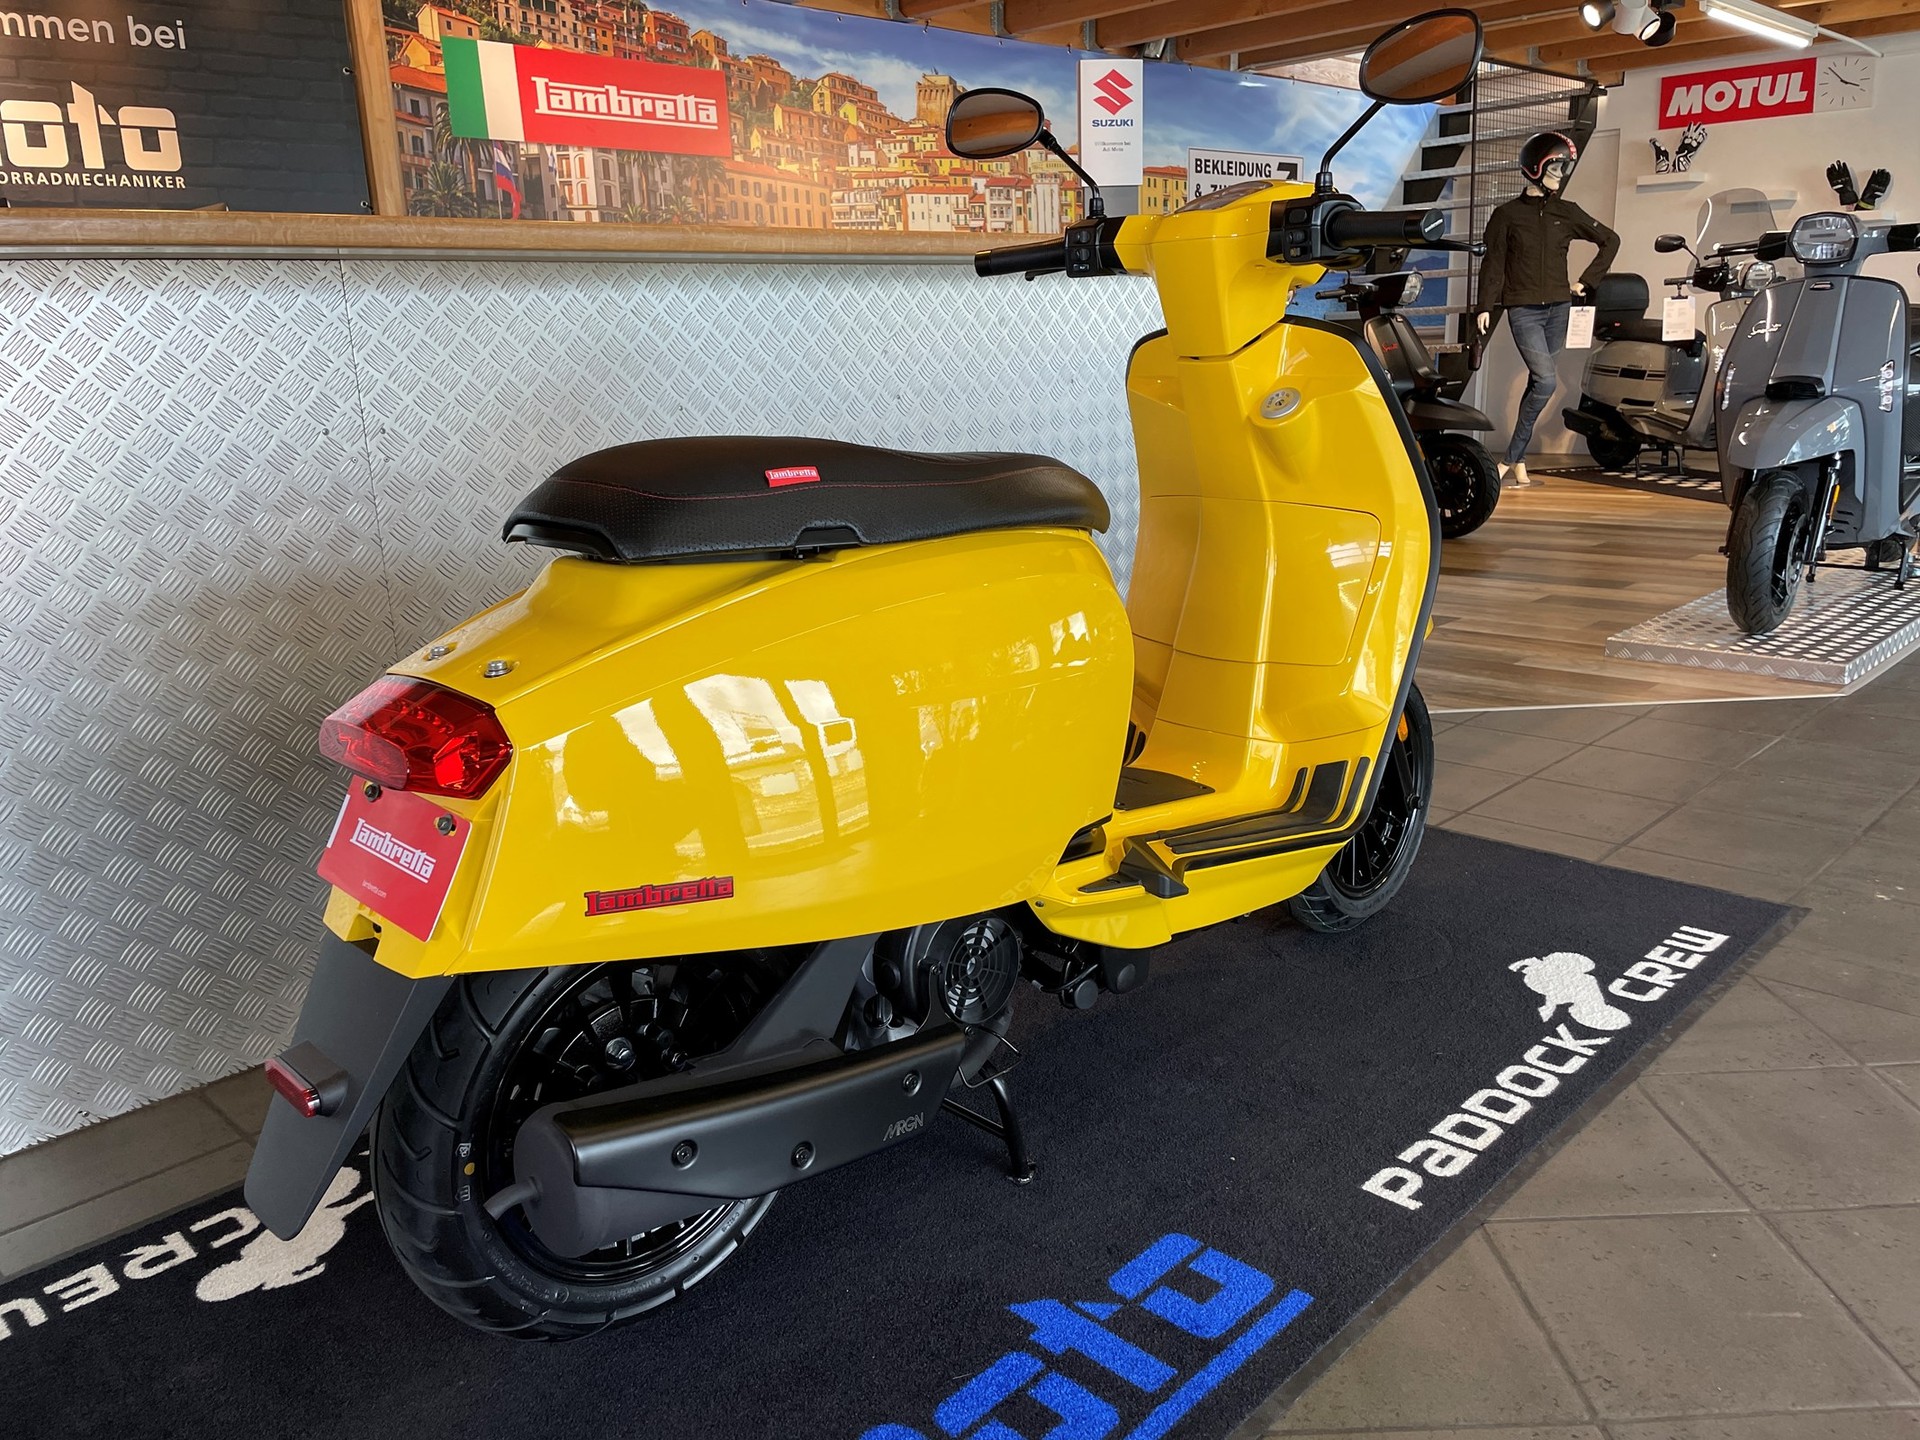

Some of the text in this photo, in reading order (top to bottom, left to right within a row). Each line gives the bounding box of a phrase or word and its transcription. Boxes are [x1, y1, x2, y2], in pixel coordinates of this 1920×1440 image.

[127, 15, 187, 50] bei
[531, 76, 719, 130] Lambretta
[1666, 72, 1808, 117] MOTUL
[0, 80, 182, 172] oto
[1092, 119, 1134, 127] SUZUKI
[0, 171, 186, 189] ORRADMECHANIKER
[1195, 158, 1272, 178] BEKLEIDUNG
[349, 818, 436, 883] Lambretta
[584, 876, 734, 917] Lambretta
[1608, 925, 1731, 1002] CREW
